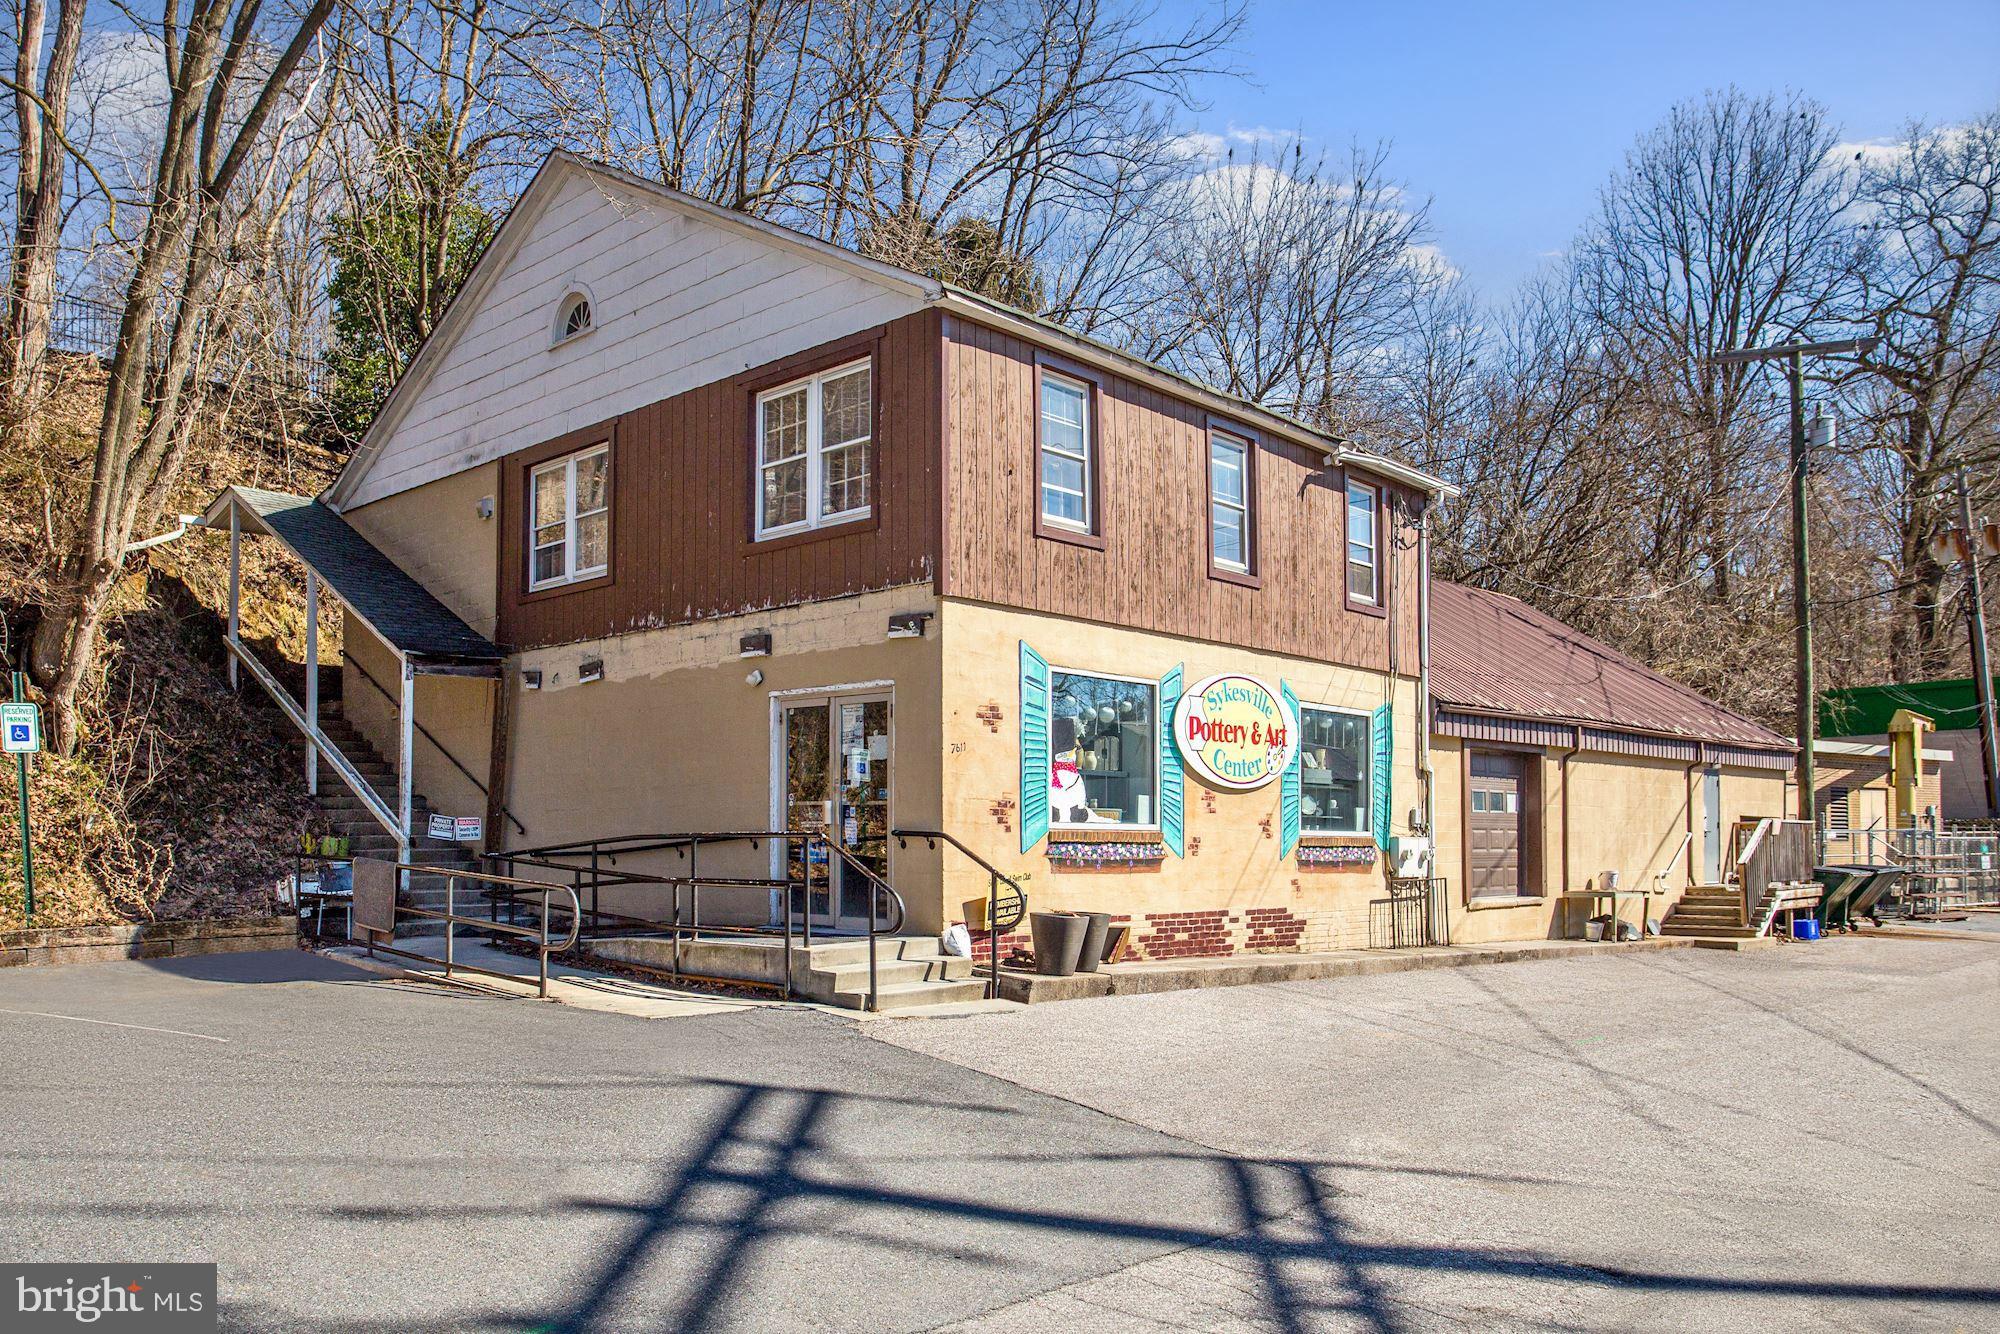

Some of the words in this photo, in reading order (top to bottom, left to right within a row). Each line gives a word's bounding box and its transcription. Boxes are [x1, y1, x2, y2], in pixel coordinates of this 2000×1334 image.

[1207, 682, 1272, 719] Sykesville
[1189, 716, 1249, 749] Pottery
[1251, 721, 1262, 745] &
[1264, 722, 1288, 749] Art
[1213, 748, 1262, 778] Center
[431, 822, 453, 831] PROPERTY
[434, 817, 452, 825] PRIVATE
